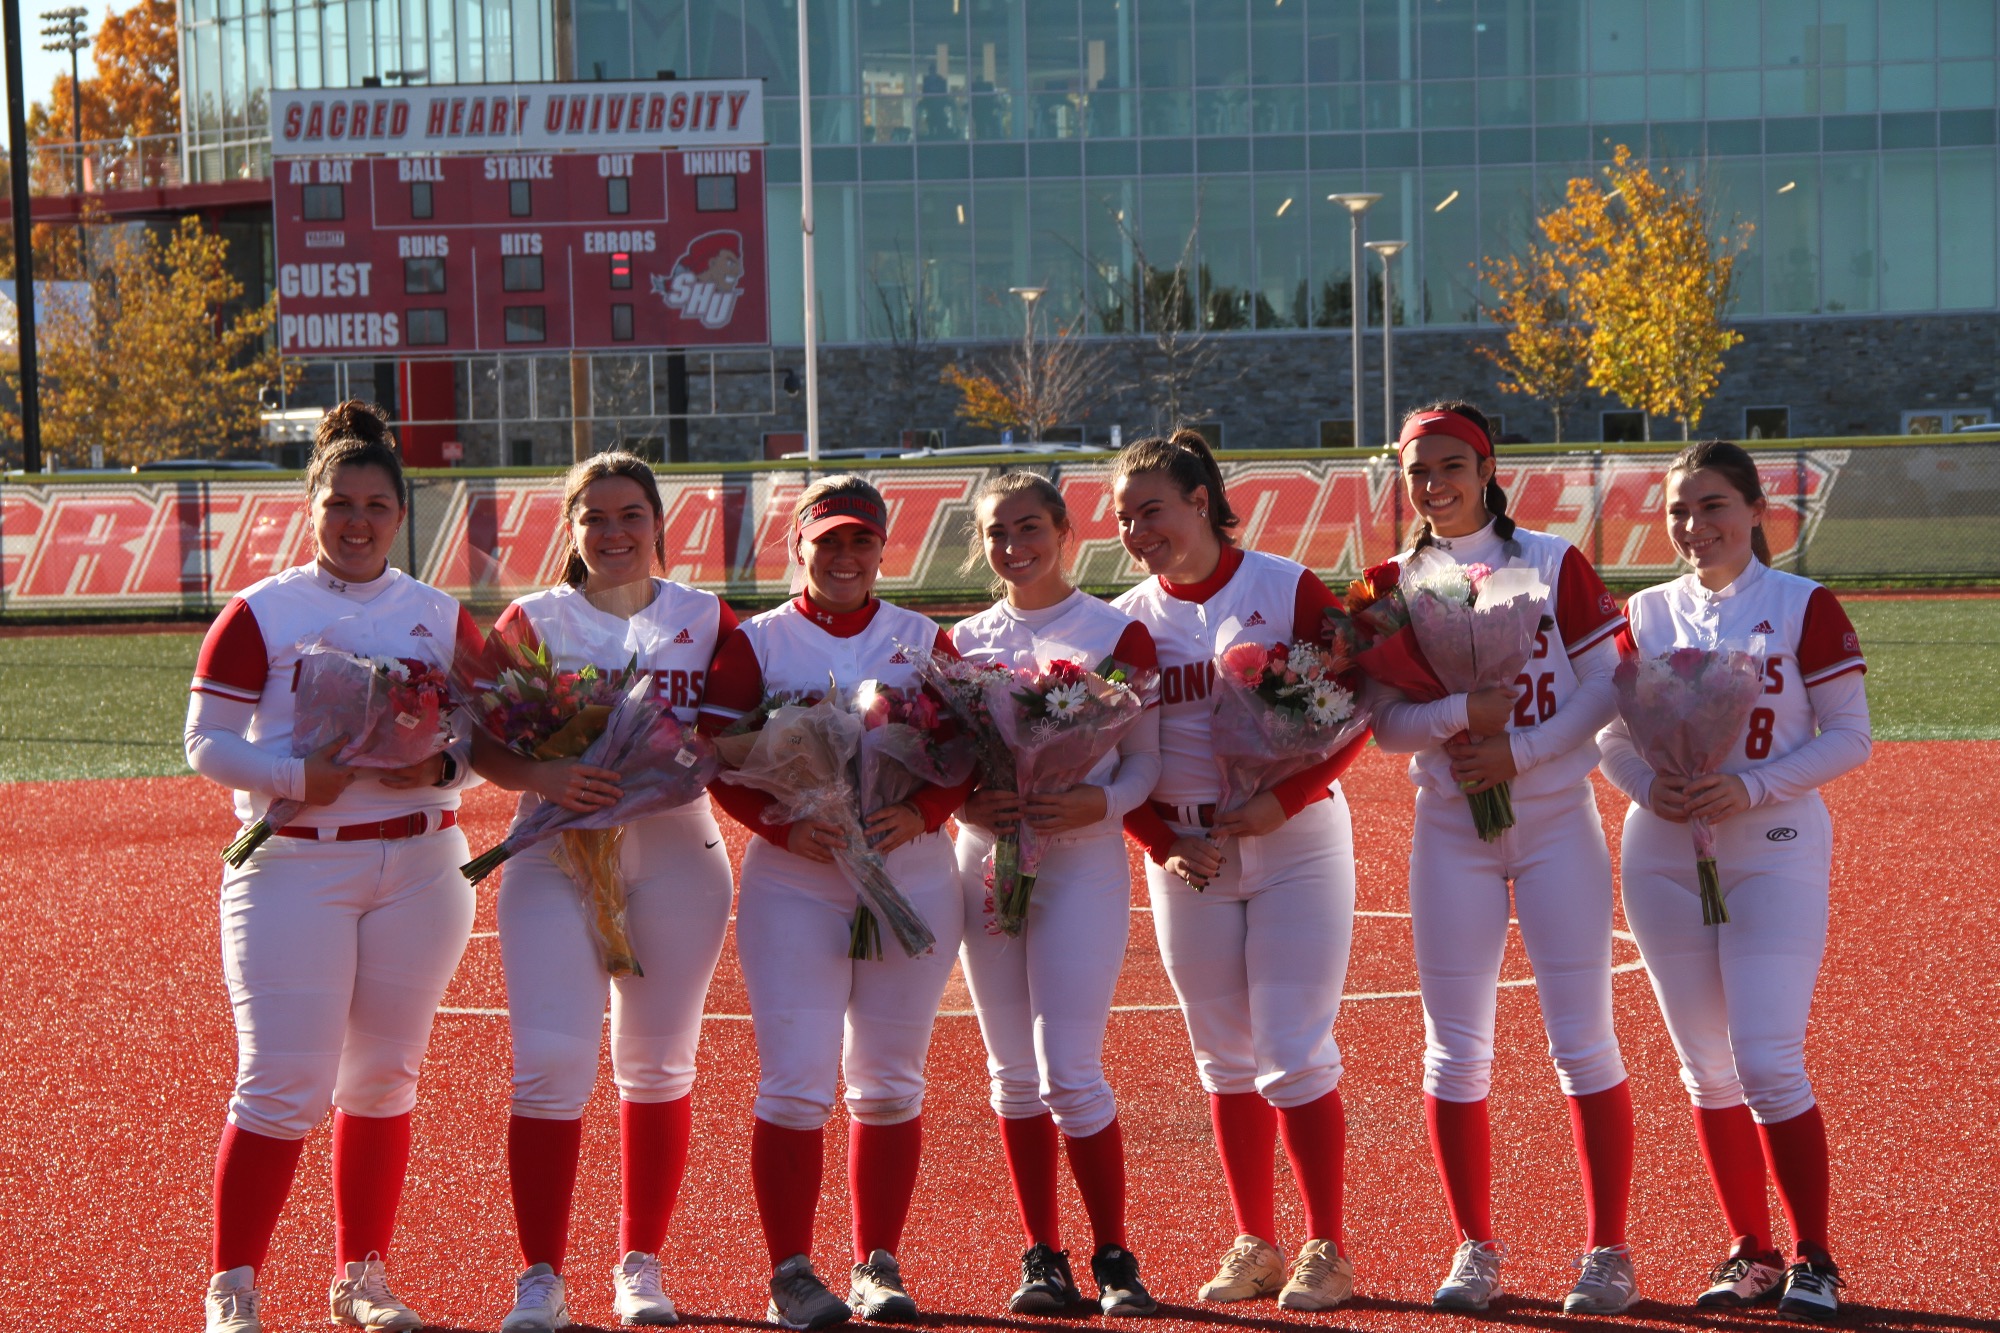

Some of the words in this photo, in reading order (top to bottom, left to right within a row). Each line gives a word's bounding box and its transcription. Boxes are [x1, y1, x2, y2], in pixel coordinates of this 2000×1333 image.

[283, 99, 410, 141] SACRED
[426, 95, 530, 138] HEART
[544, 90, 750, 135] UNIVERSITY
[290, 161, 315, 184] AT
[319, 160, 354, 183] BAT
[399, 159, 445, 182] BALL
[484, 157, 553, 180] STRIKE
[597, 154, 634, 177] OUT
[683, 151, 751, 175] INNING
[399, 236, 449, 258] RUNS
[501, 233, 543, 255] HITS
[583, 231, 656, 253] ERRORS
[281, 262, 372, 298] GUEST
[666, 272, 735, 327] SHU
[281, 312, 400, 349] PIONEERS
[811, 498, 850, 518] SACRED
[852, 497, 878, 518] HEART
[1513, 672, 1557, 727] 26
[1745, 707, 1775, 760] 8
